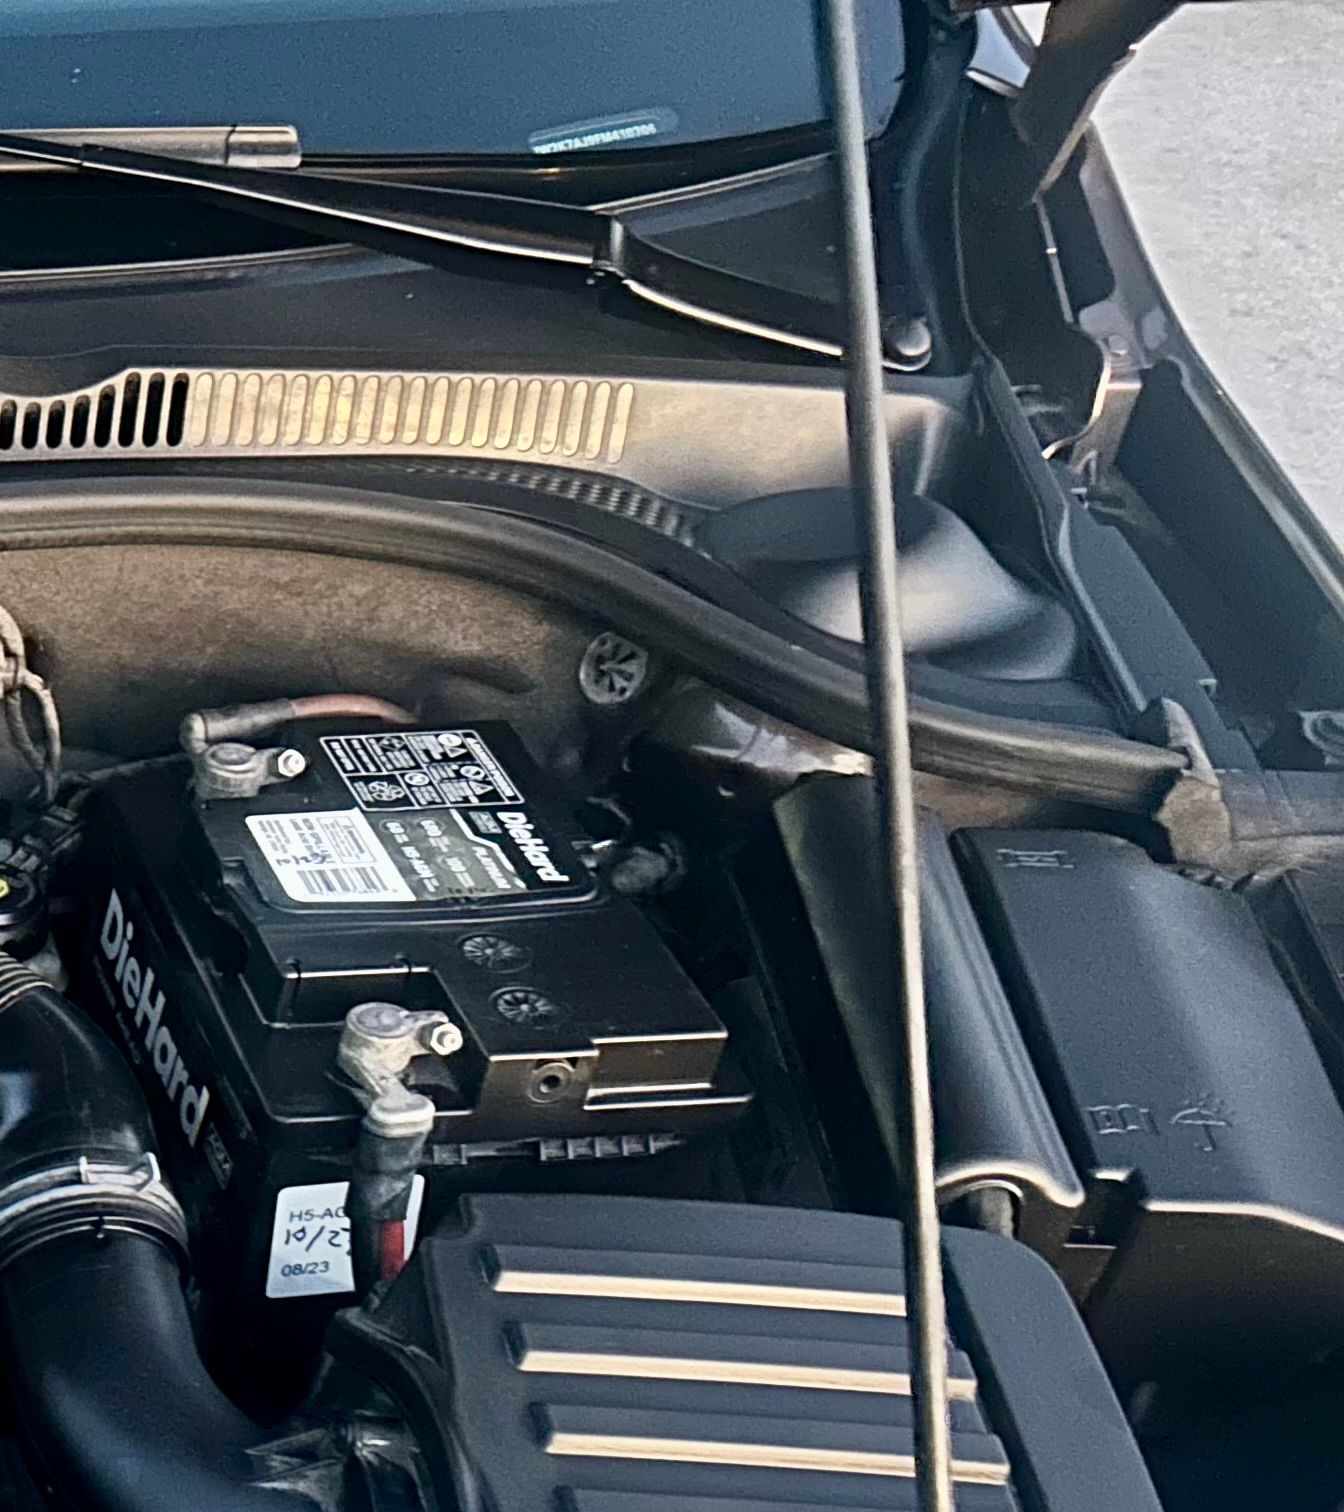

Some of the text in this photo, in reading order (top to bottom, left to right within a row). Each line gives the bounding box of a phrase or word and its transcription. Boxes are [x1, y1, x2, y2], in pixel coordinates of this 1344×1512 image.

[497, 811, 570, 882] DieHard
[100, 888, 210, 1148] DieHard
[281, 1261, 330, 1278] 08/23
